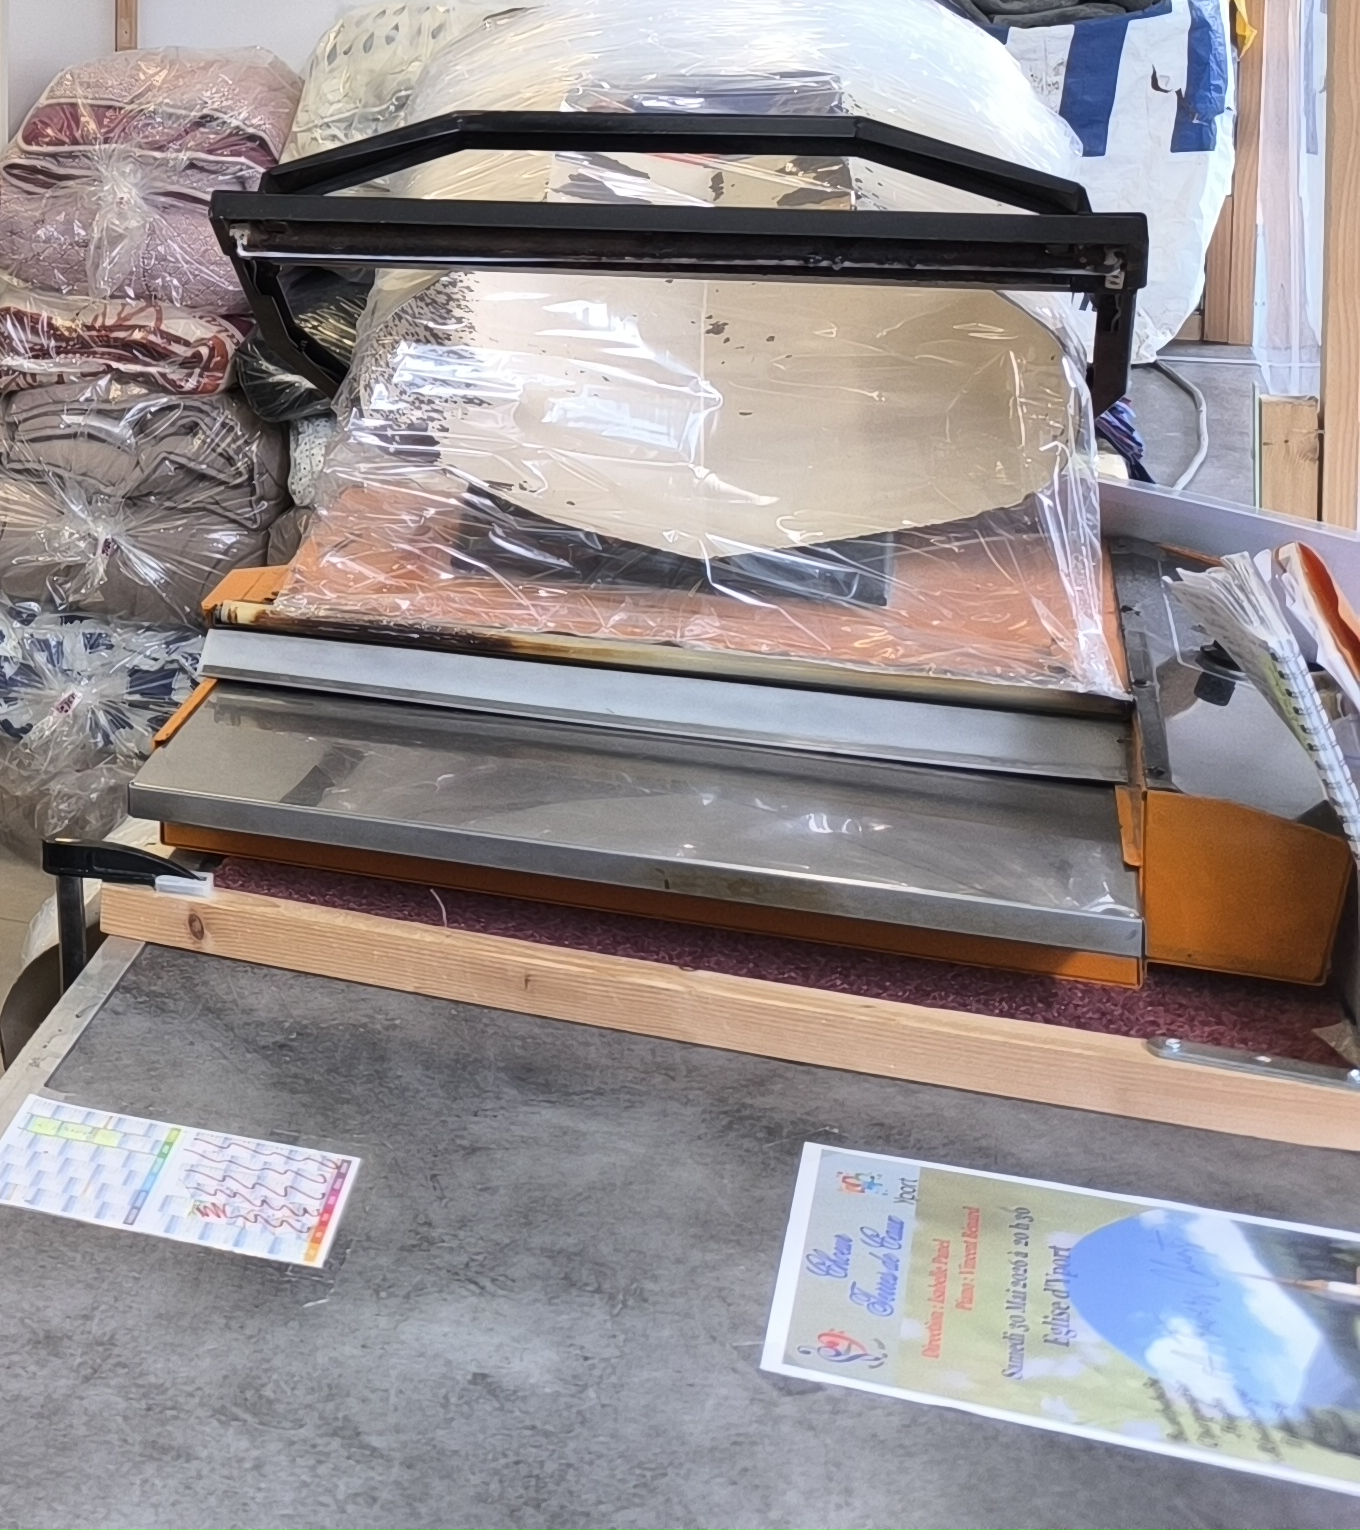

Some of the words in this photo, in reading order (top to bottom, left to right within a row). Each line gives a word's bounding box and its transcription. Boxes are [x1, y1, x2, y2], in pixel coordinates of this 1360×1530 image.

[893, 1176, 921, 1206] Yport
[1006, 1258, 1028, 1289] 2026
[1004, 1287, 1028, 1313] Mai
[1000, 1330, 1028, 1380] Samedi
